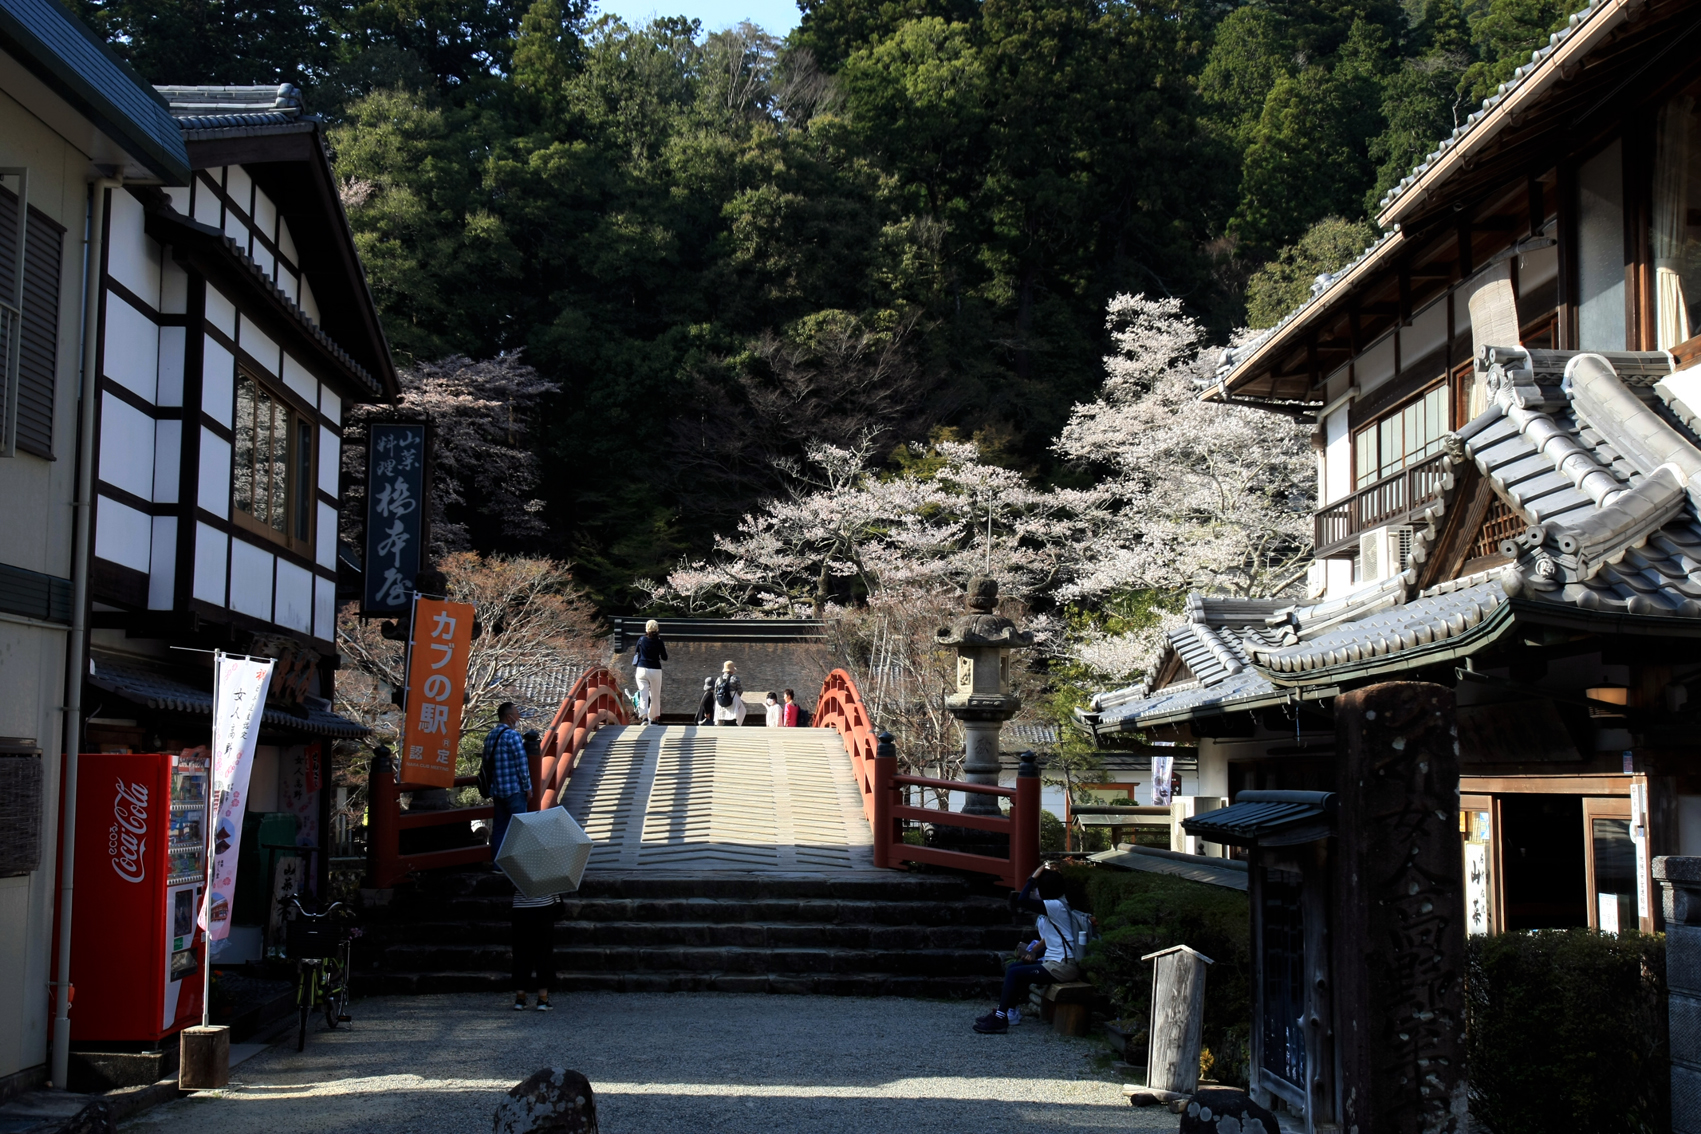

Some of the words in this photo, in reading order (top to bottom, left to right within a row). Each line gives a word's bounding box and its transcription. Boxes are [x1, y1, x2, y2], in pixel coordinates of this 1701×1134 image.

[376, 433, 397, 477] 料理
[398, 431, 421, 471] 山菜
[375, 475, 417, 606] 橋本屋
[418, 610, 457, 735] カブの駅
[224, 687, 247, 758] 女人高野
[409, 745, 450, 764] 認定
[112, 776, 149, 883] Coca-Cola
